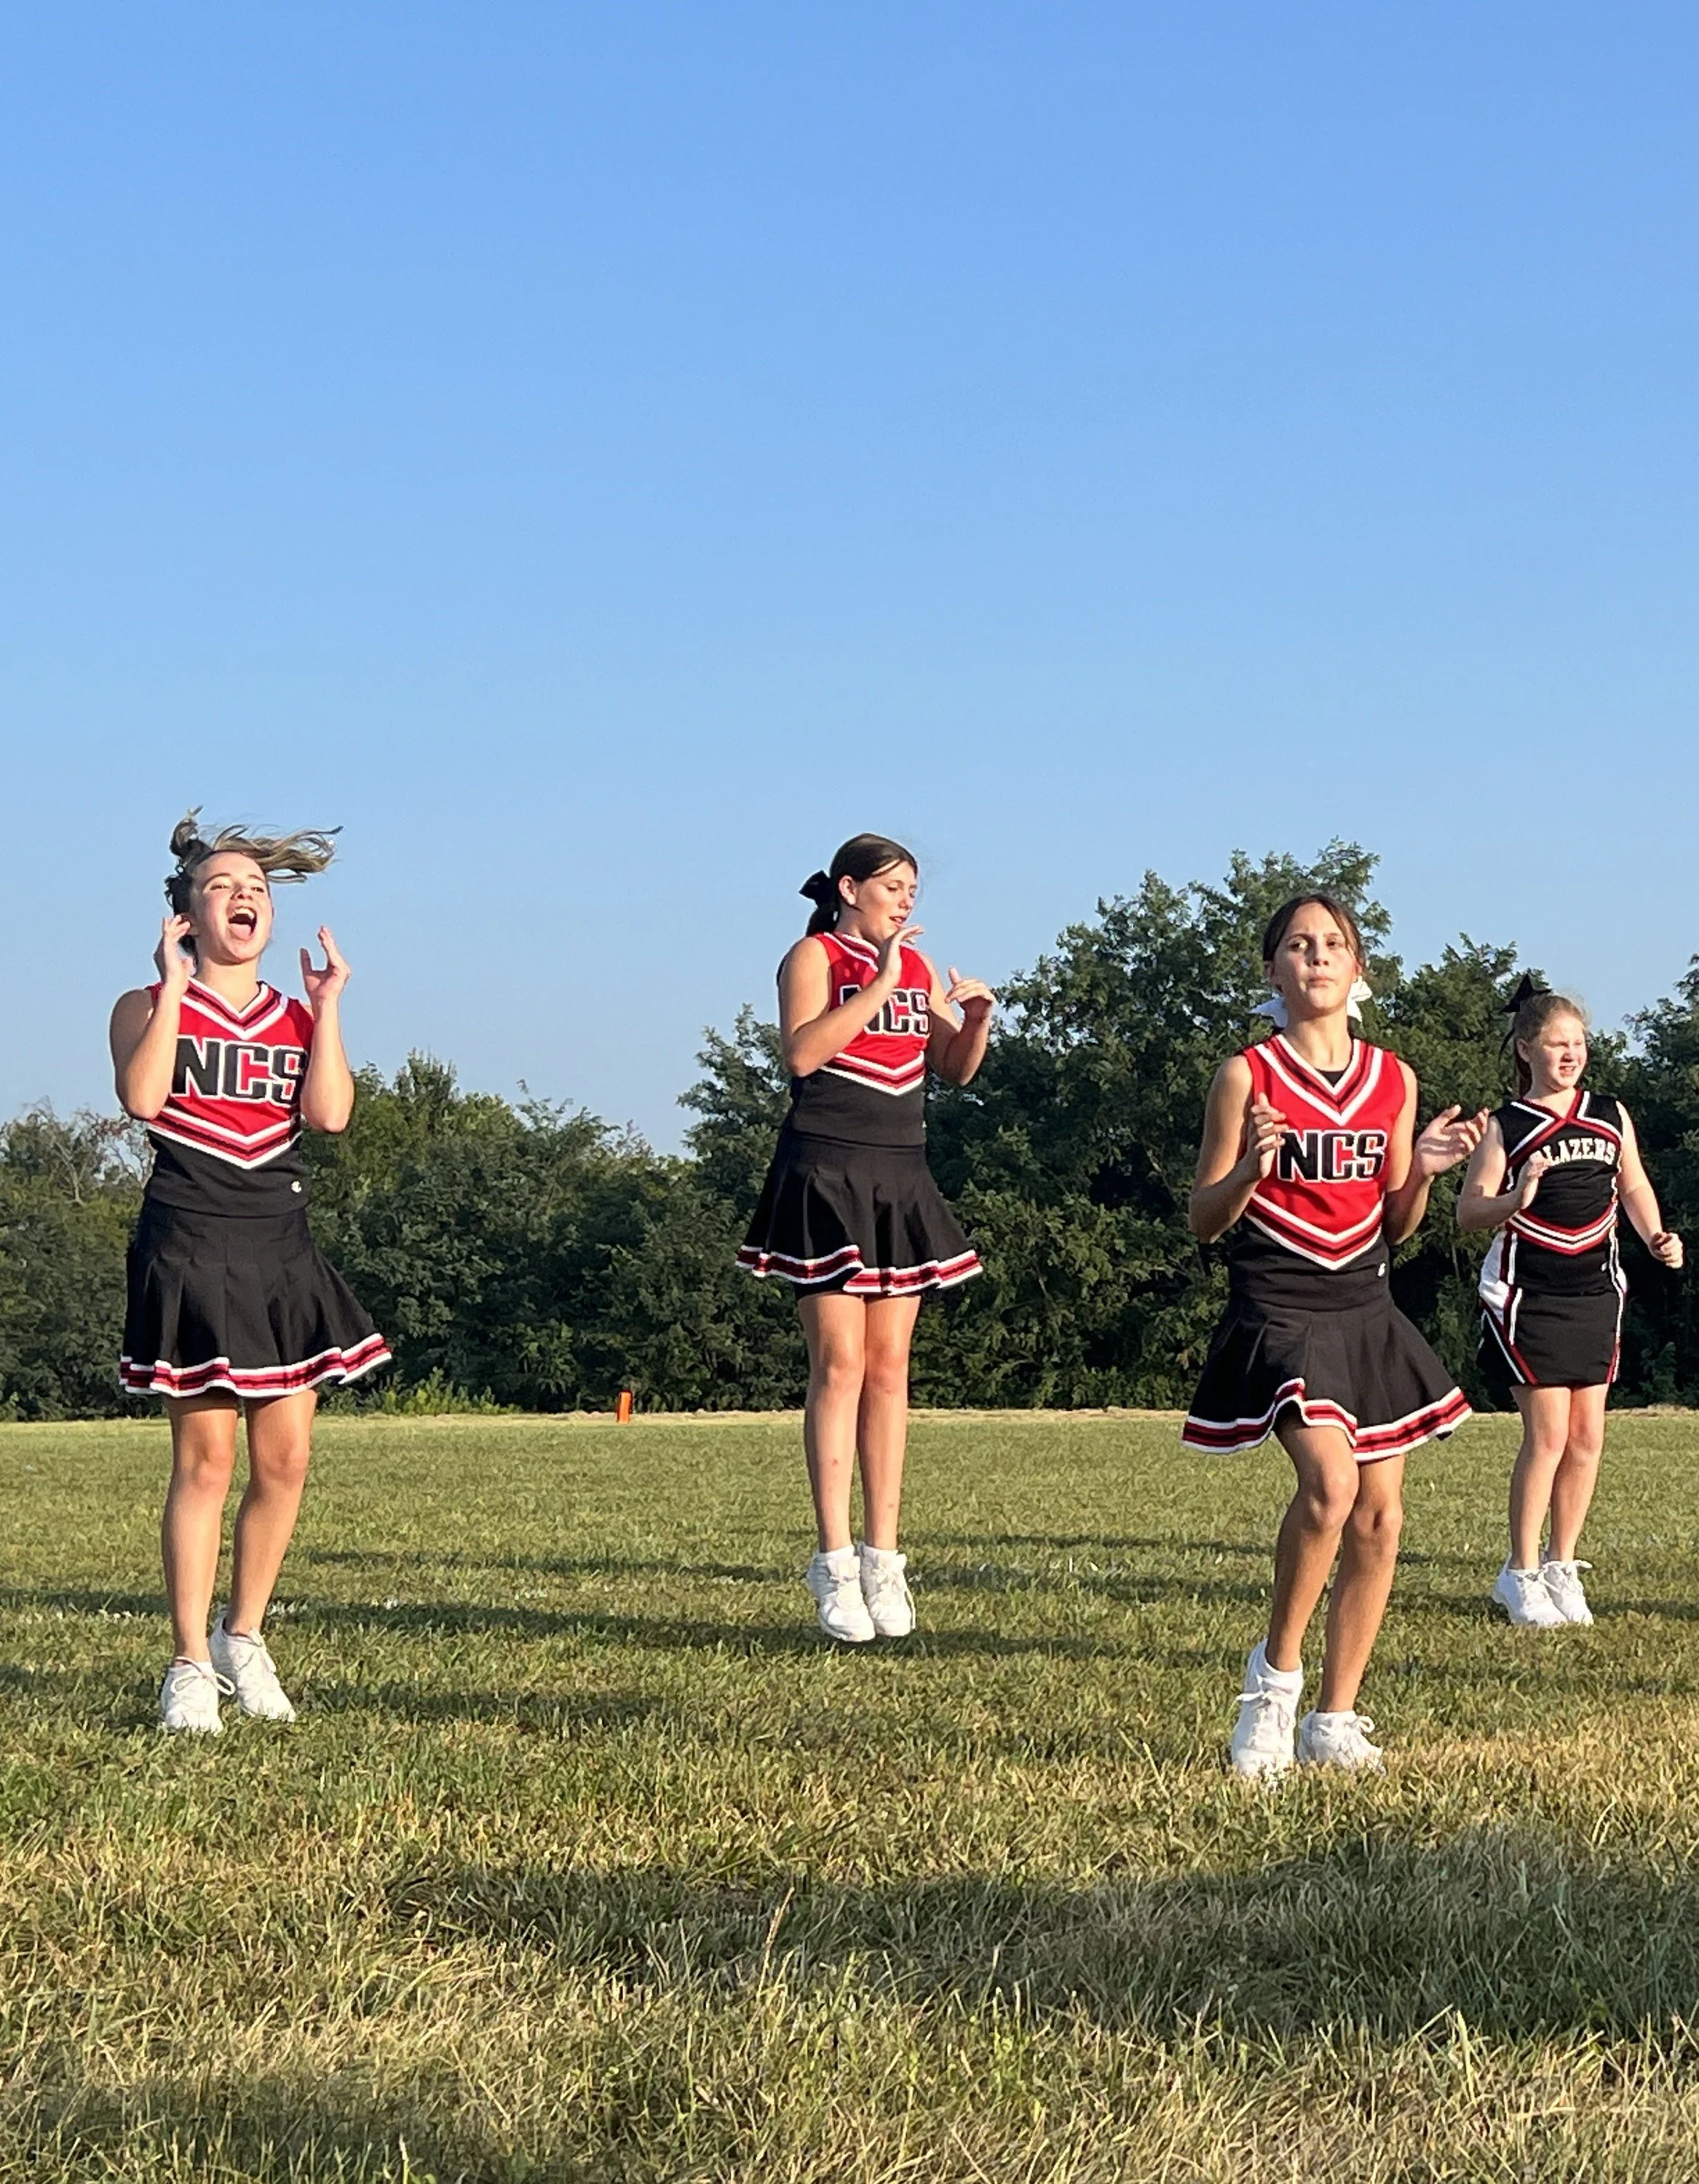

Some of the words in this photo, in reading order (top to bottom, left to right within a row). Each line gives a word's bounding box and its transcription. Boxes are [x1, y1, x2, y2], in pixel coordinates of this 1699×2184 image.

[172, 1034, 309, 1107] NCS
[1278, 1129, 1388, 1183] NCS
[1531, 1138, 1616, 1166] LAZERS
